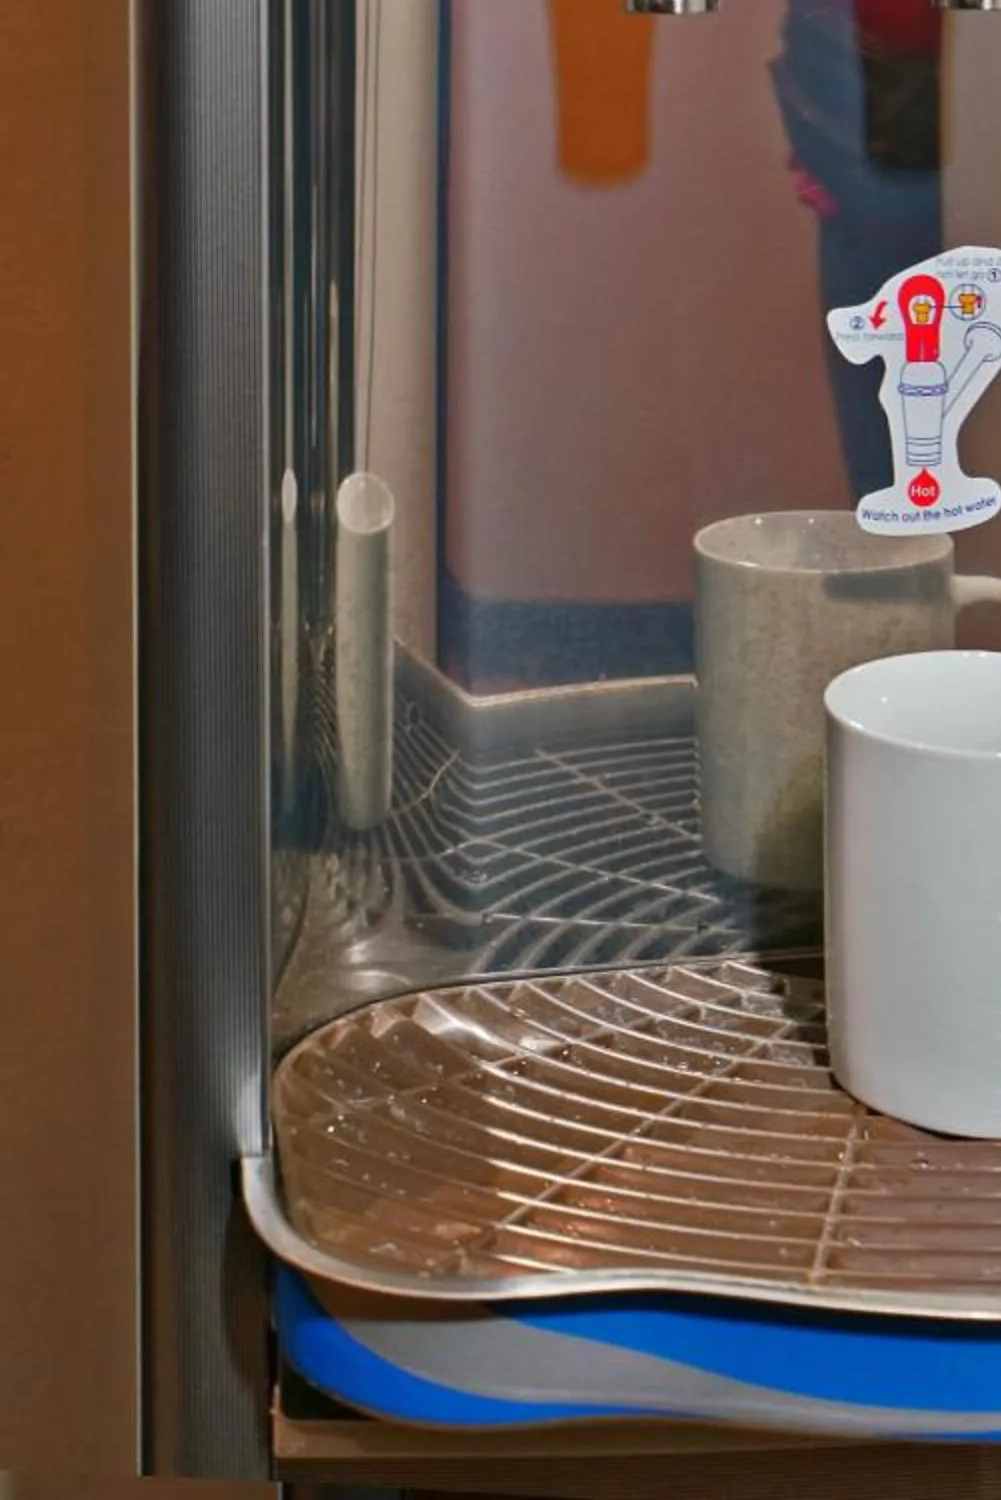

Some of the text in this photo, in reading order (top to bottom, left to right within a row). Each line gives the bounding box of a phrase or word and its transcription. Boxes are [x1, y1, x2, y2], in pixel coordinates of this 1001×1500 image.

[910, 484, 936, 497] Hot
[861, 496, 997, 522] Watch out the hot water
